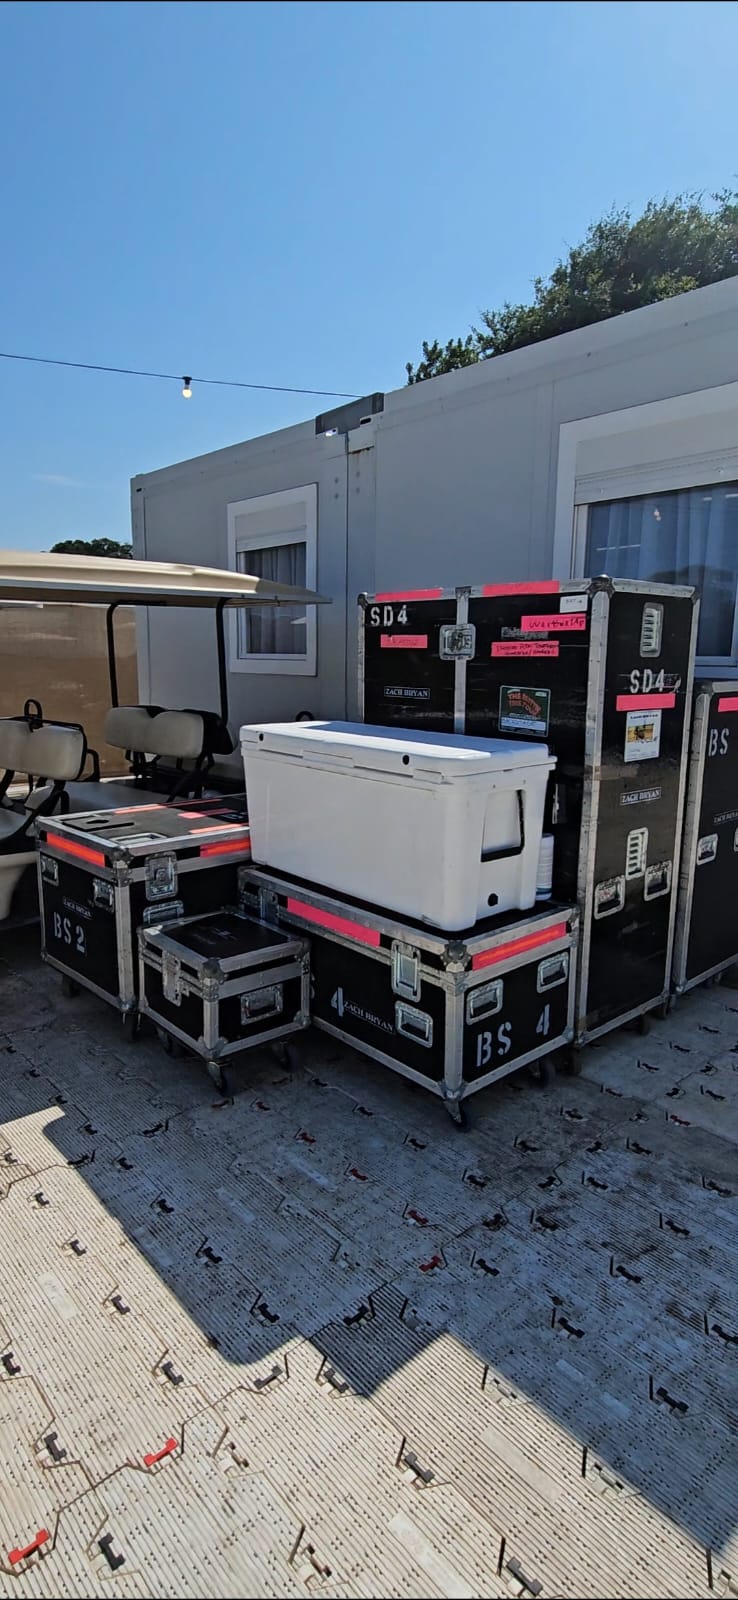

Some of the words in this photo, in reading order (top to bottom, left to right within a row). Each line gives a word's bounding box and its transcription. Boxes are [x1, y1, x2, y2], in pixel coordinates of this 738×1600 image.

[370, 604, 408, 627] SD4
[384, 688, 403, 697] ZACH
[404, 689, 429, 698] BRYAN
[630, 669, 665, 694] SD4
[708, 728, 730, 757] BS
[621, 792, 639, 803] ZACH
[639, 789, 661, 800] BRYAN
[53, 911, 72, 945] BS
[75, 925, 85, 953] 2
[330, 987, 344, 1017] 4
[344, 1001, 365, 1017] ZACH
[365, 1011, 394, 1032] BRYAN
[476, 1021, 512, 1067] BS
[535, 1004, 551, 1036] 4
